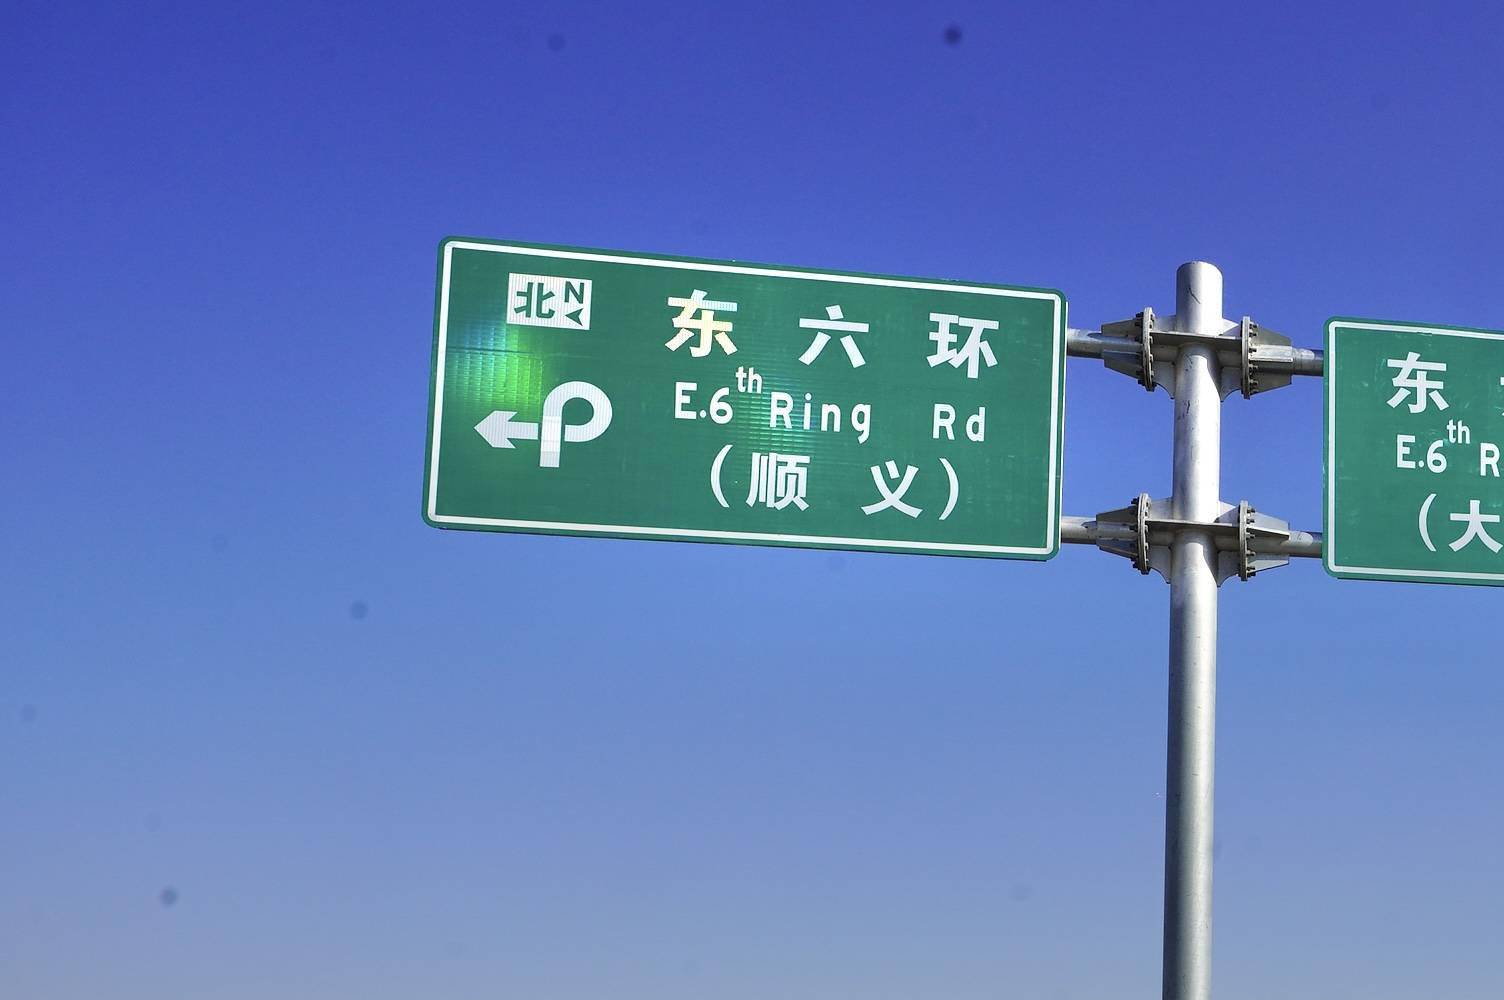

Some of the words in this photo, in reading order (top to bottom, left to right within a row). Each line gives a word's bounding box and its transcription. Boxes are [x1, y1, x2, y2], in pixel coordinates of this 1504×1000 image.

[514, 282, 556, 320] 北
[564, 281, 585, 304] N
[665, 289, 1000, 379] 东六环
[769, 393, 872, 443] Ring
[933, 403, 986, 442] Rd
